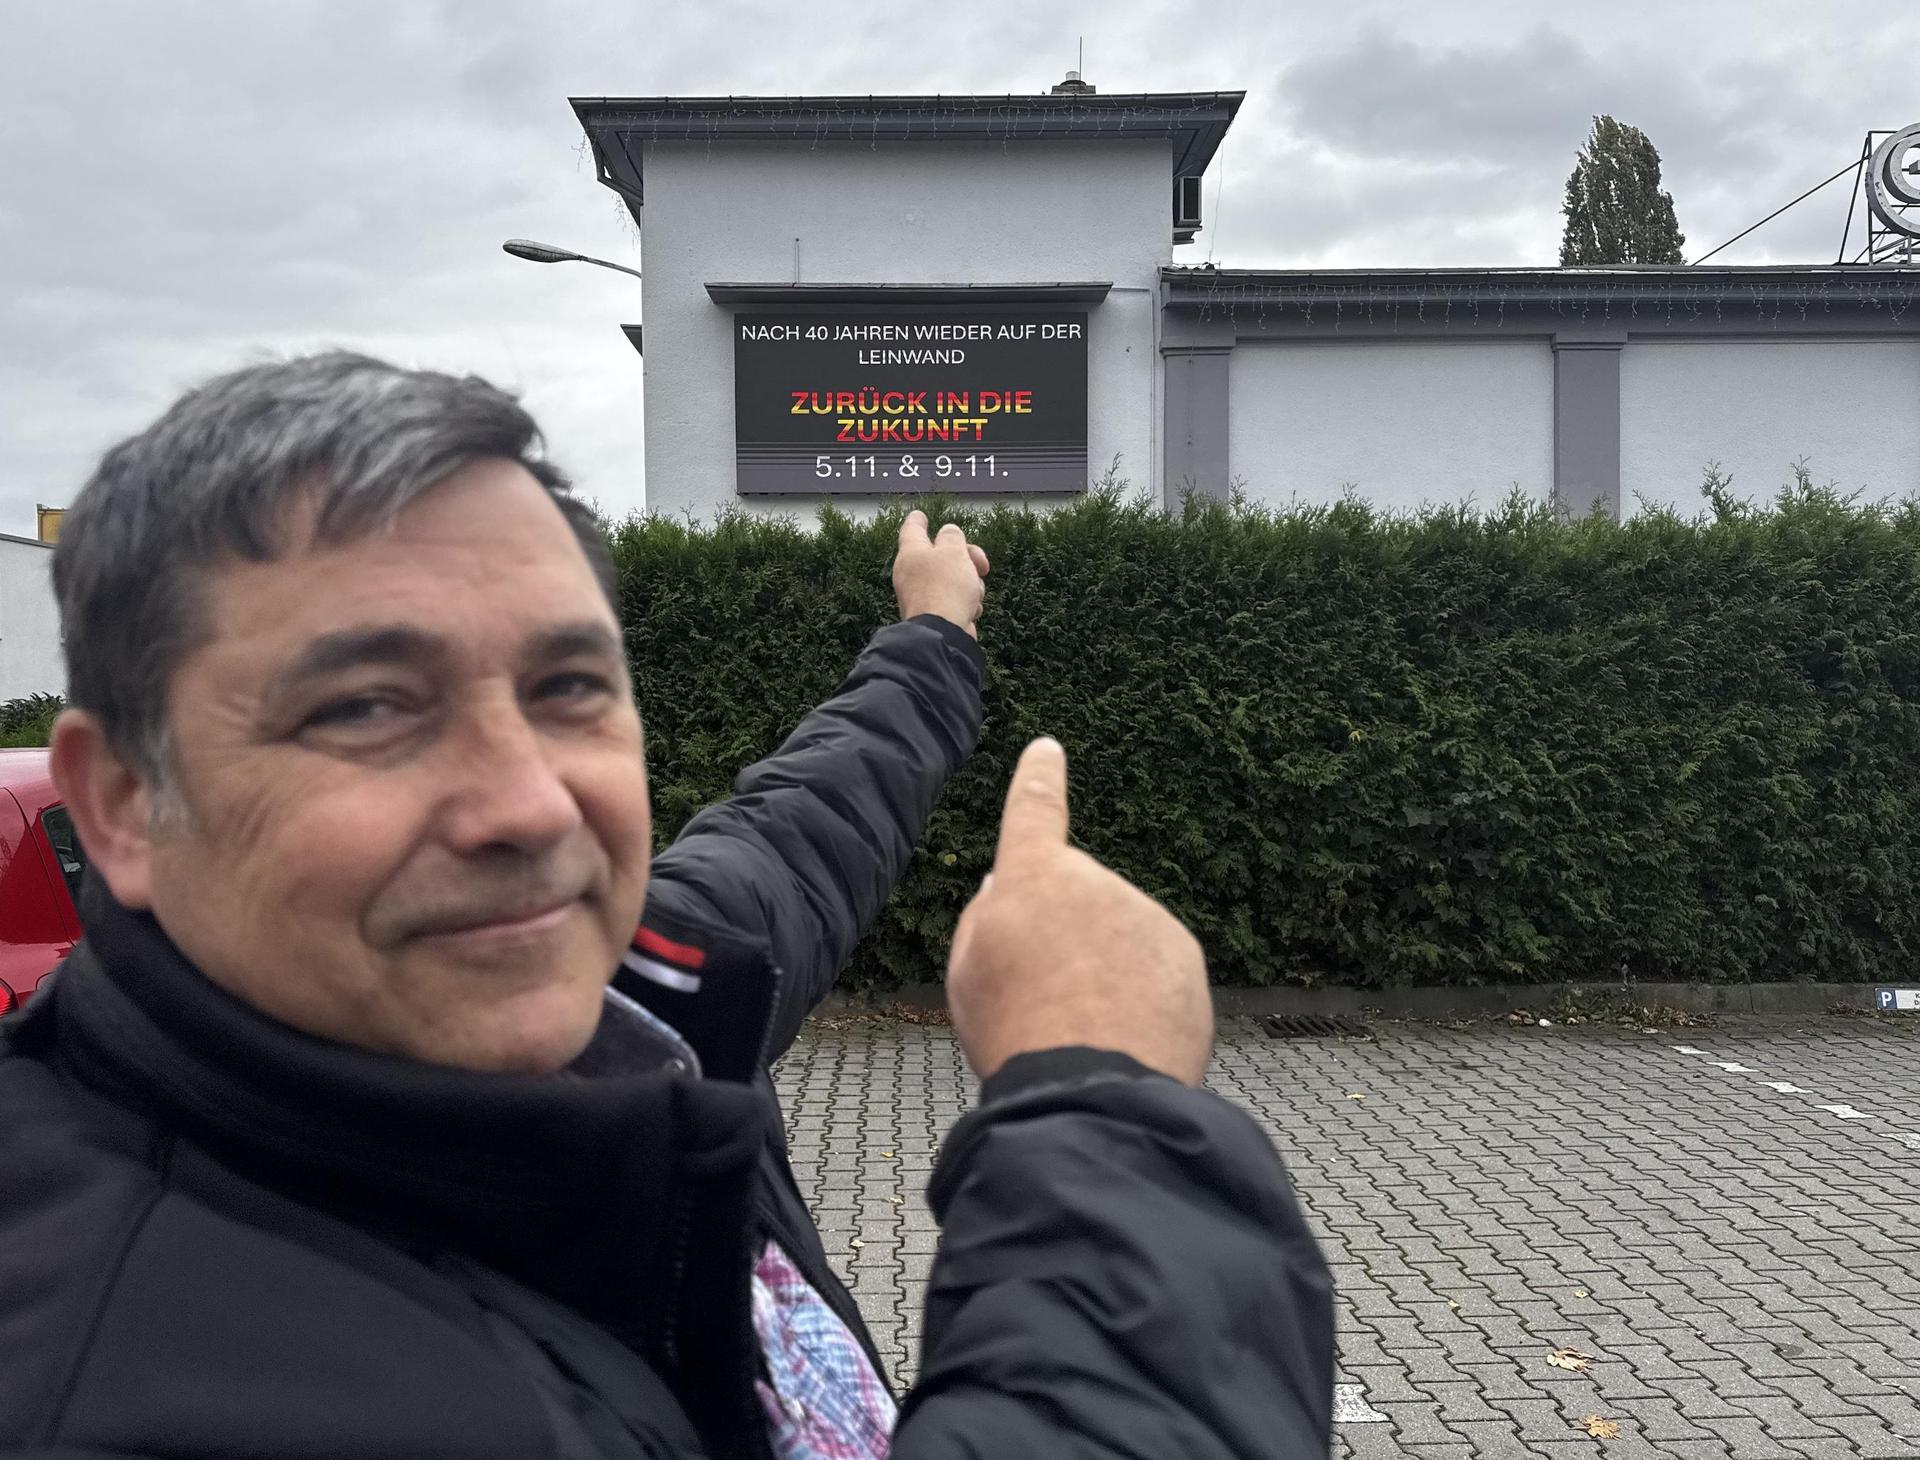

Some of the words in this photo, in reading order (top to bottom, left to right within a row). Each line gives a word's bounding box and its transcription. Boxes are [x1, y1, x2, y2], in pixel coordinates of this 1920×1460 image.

[742, 325, 800, 341] NACH
[804, 325, 829, 341] 40
[832, 325, 909, 341] JAHREN
[913, 324, 993, 341] WIEDER
[996, 324, 1037, 340] AUF
[1041, 323, 1082, 340] DER
[858, 349, 965, 365] LEINWAND
[790, 386, 928, 415] ZURÜCK
[936, 391, 969, 415] IN
[979, 390, 1033, 415] DIE
[836, 418, 989, 442] ZUKUNFT
[815, 455, 889, 478] 5.11.
[898, 454, 921, 478] &
[935, 455, 1010, 478] 9.11.
[1881, 991, 1893, 1007] P
